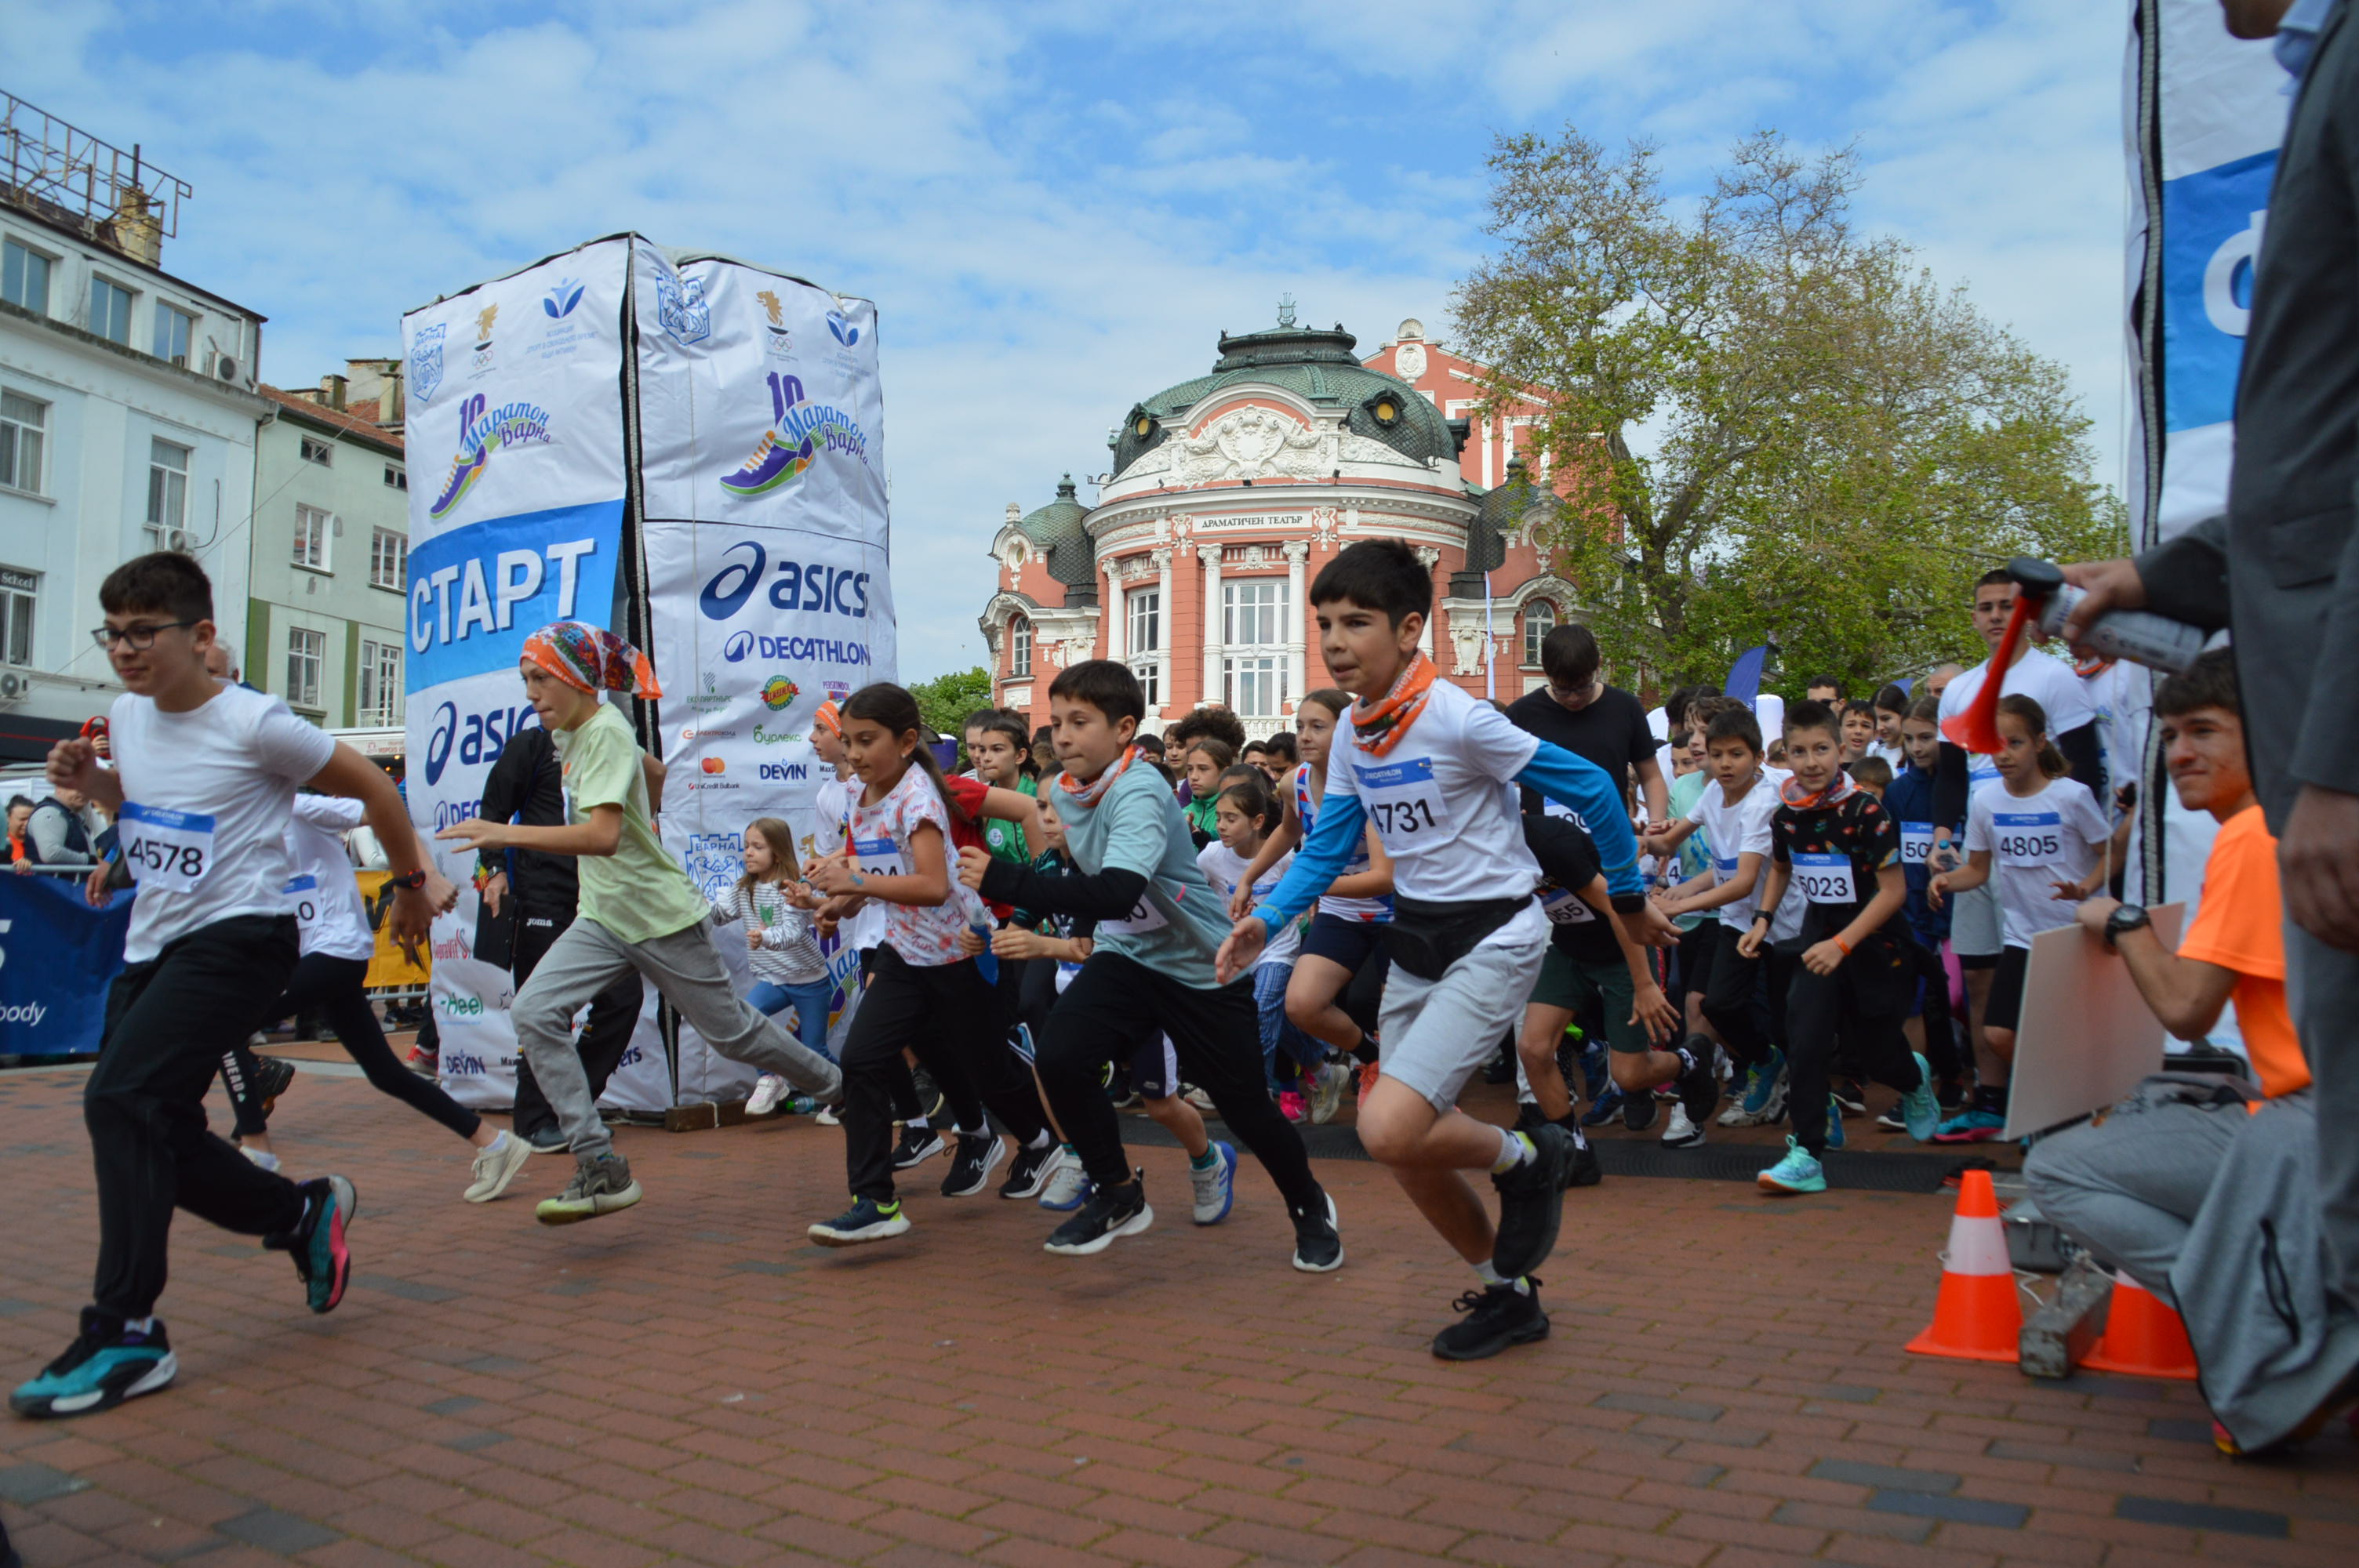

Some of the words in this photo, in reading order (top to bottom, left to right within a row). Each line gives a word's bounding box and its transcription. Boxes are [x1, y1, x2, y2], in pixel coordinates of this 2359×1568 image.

[767, 371, 805, 426] 10
[460, 393, 485, 448] 10
[463, 402, 550, 459] Маратон
[497, 422, 551, 448] Варна
[783, 405, 867, 448] Маратон
[822, 424, 868, 465] Варна
[1201, 517, 1264, 528] ДРАМАТИЧЕН
[1267, 515, 1303, 524] ТЕАТЪР
[412, 538, 596, 654] СТАРТ
[768, 561, 871, 618] asics
[758, 636, 871, 666] DECATHLON
[759, 764, 808, 781] DEVIN
[128, 837, 203, 877] 4578
[2001, 835, 2058, 856] 4805
[1798, 875, 1848, 896] 5023
[526, 917, 553, 927] joma
[445, 1055, 486, 1075] DEVIN
